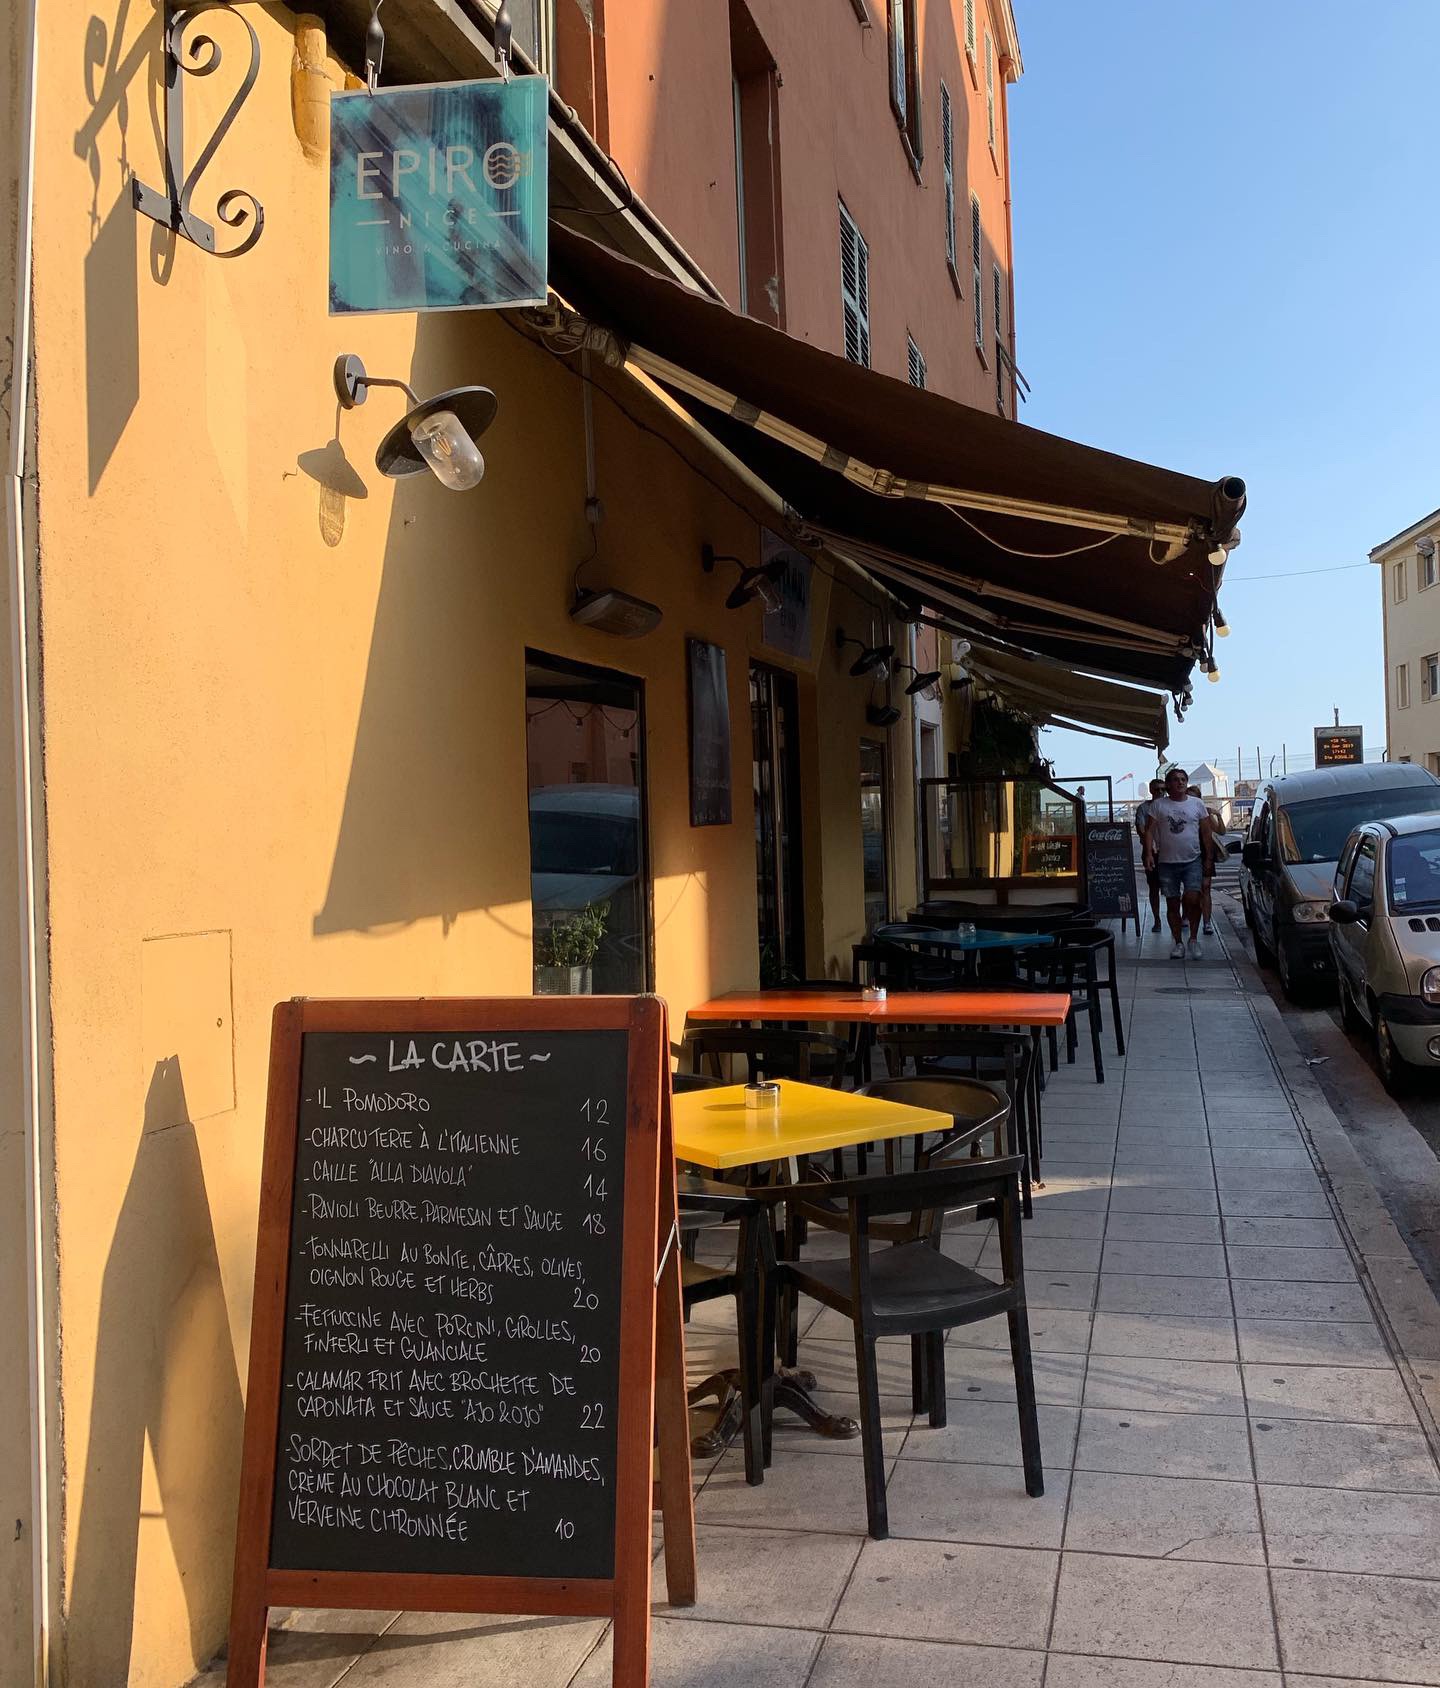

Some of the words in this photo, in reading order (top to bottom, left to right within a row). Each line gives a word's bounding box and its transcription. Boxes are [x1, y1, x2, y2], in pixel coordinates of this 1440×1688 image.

[356, 142, 521, 200] EPIRO
[400, 208, 477, 229] NICE
[375, 244, 412, 255] VINO
[388, 1039, 425, 1073] LA
[431, 1040, 525, 1073] CARTE
[317, 1086, 332, 1109] IL
[342, 1087, 431, 1112] POMODORO
[580, 1098, 610, 1125] 12
[418, 1124, 430, 1150] À
[438, 1128, 521, 1155] L'ITALIENNE
[581, 1136, 607, 1162] 16
[583, 1173, 608, 1202] 14
[498, 1207, 519, 1227] ET
[524, 1206, 563, 1231] SAUCE
[582, 1213, 607, 1235] 18
[401, 1242, 418, 1264] AU
[541, 1255, 586, 1285] OLIVES,
[310, 1267, 364, 1287] OIGNON
[370, 1267, 415, 1290] ROUGE
[423, 1275, 447, 1295] ET
[451, 1277, 495, 1305] HERBS
[573, 1287, 599, 1310] 20
[389, 1310, 429, 1338] AVEC
[435, 1313, 500, 1339] PORCINI,
[506, 1315, 576, 1345] GIROLLES,
[374, 1339, 395, 1355] ET
[400, 1335, 488, 1363] GUANCIALE
[579, 1344, 601, 1363] 20
[367, 1369, 403, 1391] FRIT
[408, 1369, 445, 1392] AVEC
[450, 1371, 540, 1396] BROCHETTE
[549, 1371, 577, 1396] DE
[297, 1396, 376, 1418] CAPONATA
[383, 1399, 404, 1418] ET
[408, 1397, 455, 1419] SAUCE
[580, 1402, 605, 1430] 22
[357, 1443, 382, 1464] DE
[452, 1445, 516, 1475] CRUMBLE
[288, 1469, 335, 1494] CRÈME
[340, 1477, 361, 1498] AU
[367, 1473, 439, 1503] CHOCOLAT
[445, 1480, 500, 1510] BLANC
[507, 1489, 531, 1512] ET
[288, 1497, 365, 1531] VERVEINE
[370, 1507, 469, 1541] CITRONNÉE
[555, 1518, 575, 1540] 10
